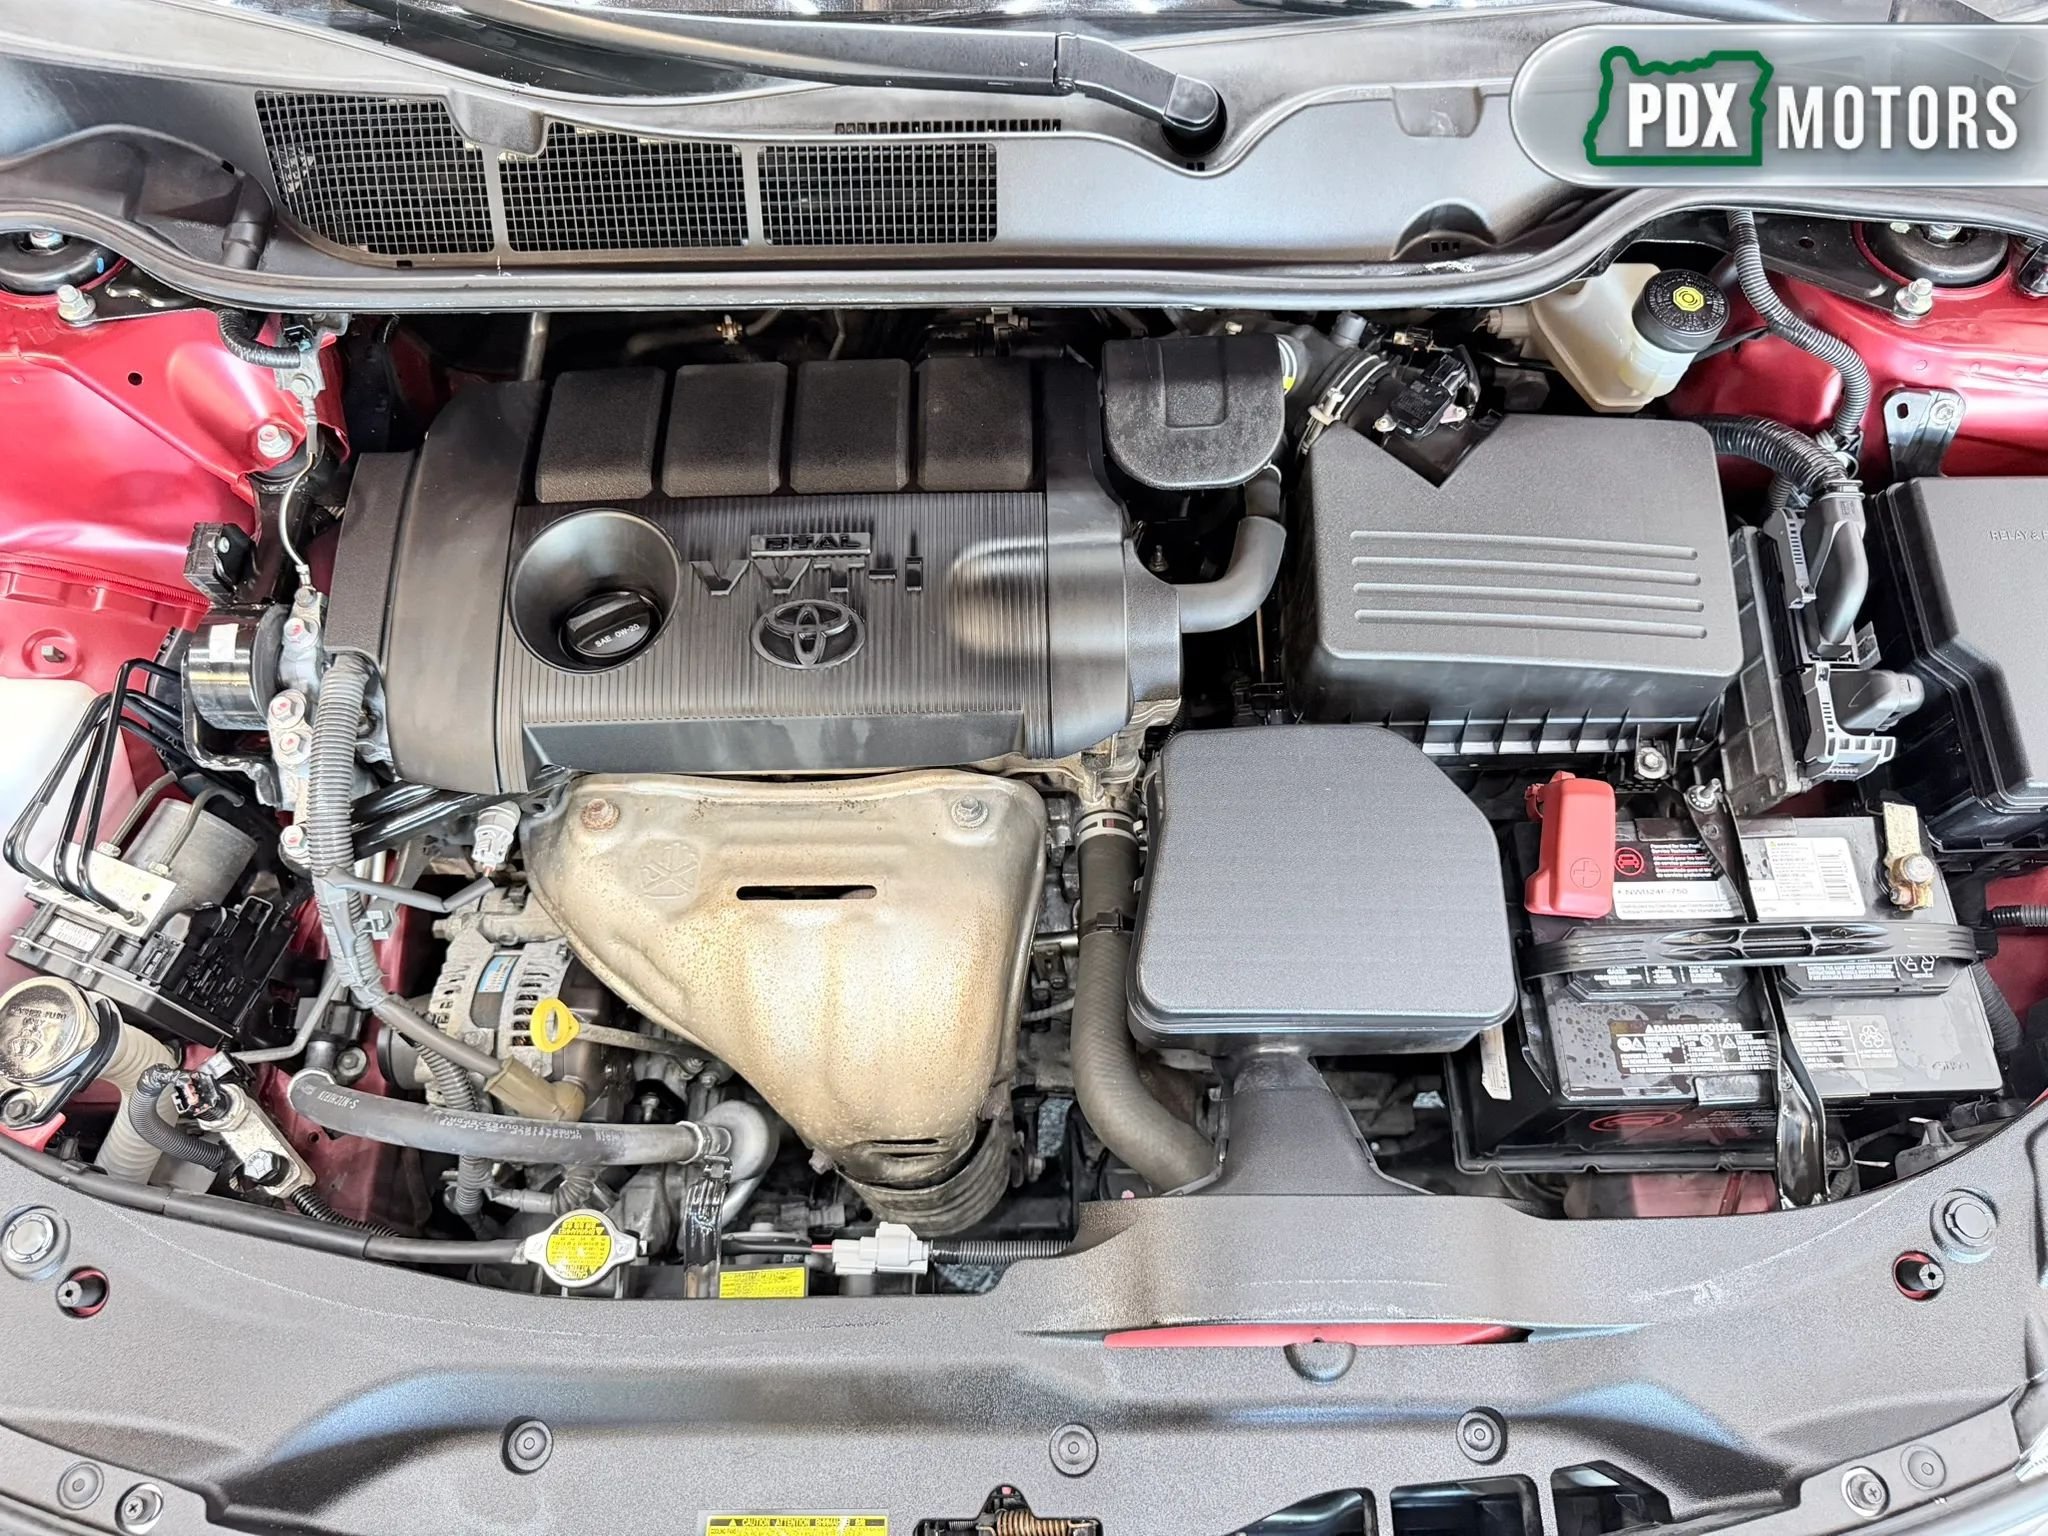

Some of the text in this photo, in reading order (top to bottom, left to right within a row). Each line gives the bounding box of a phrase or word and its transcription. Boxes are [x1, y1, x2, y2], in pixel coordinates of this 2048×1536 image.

[1989, 530, 2028, 540] RELAY
[594, 623, 641, 648] SAE 0W-20
